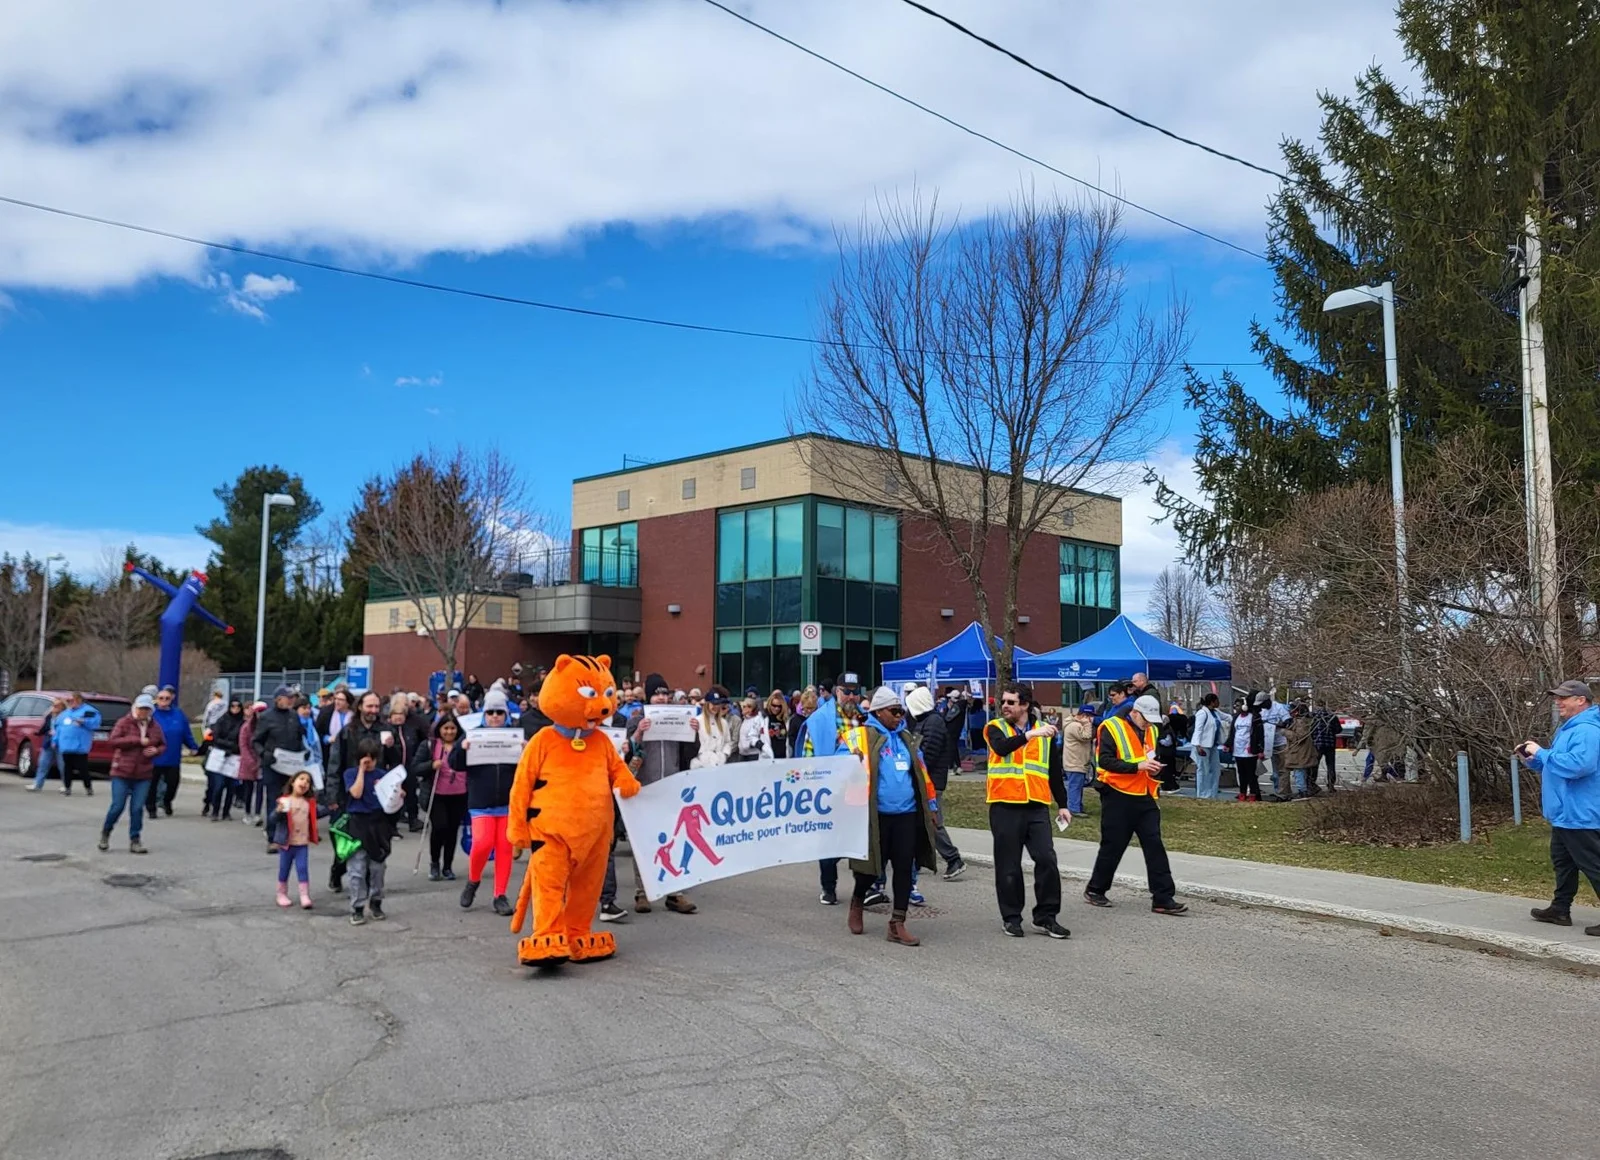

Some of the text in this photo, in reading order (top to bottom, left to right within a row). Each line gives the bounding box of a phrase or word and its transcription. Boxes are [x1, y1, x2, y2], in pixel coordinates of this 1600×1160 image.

[710, 780, 832, 826] Québec
[715, 821, 833, 846] Marche pour l'autisme
